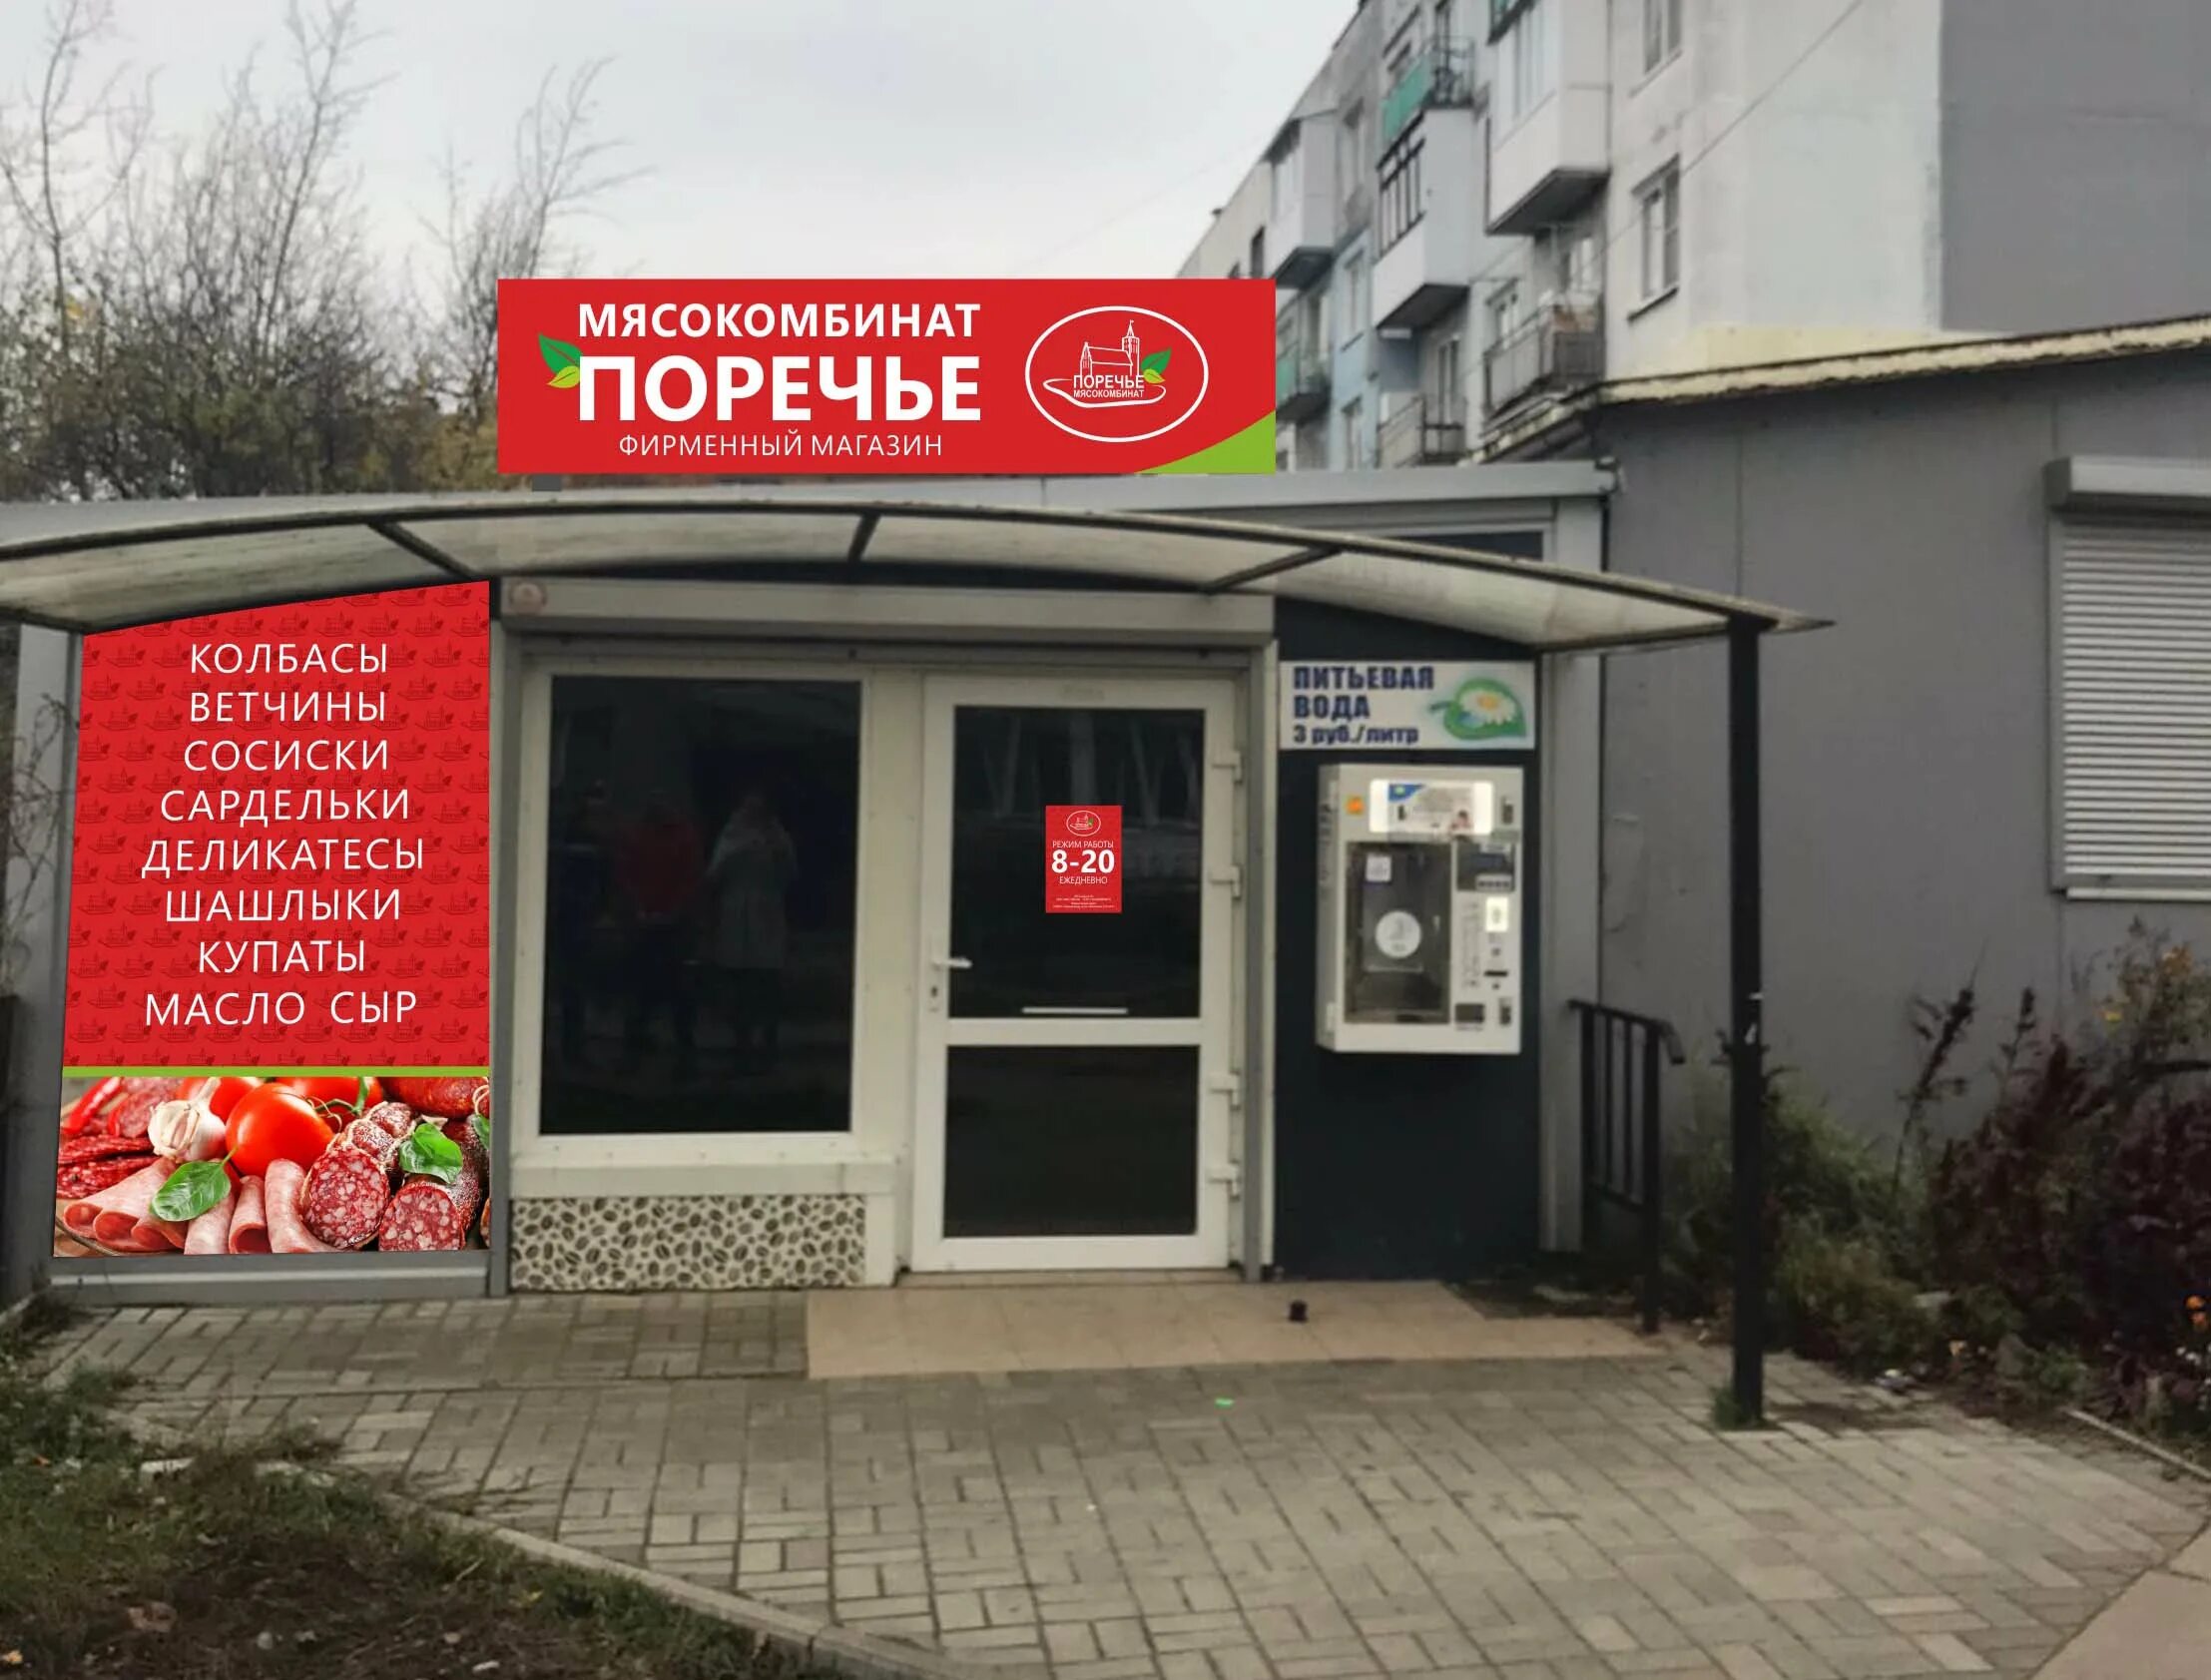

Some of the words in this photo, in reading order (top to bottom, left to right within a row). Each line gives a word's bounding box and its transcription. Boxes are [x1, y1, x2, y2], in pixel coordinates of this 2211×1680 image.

[579, 302, 981, 338] МЯСОКОМБИНАТ
[579, 354, 981, 422] ПОРЕЧЬЕ
[1073, 374, 1145, 389] ПОРЕЧЬЕ
[1073, 389, 1145, 398] МЯСОКОМБИНАТ
[619, 429, 802, 456] ФИРМЕННЫЙ
[812, 434, 941, 456] МАГАЗИН
[191, 643, 387, 674] КОЛБАСЫ
[1293, 665, 1435, 691] ПИТЬЕВАЯ
[190, 691, 386, 723] ВЕТЧИНЫ
[1293, 694, 1372, 723] ВОДА
[1293, 724, 1307, 745] 3
[1311, 724, 1419, 746] руб./литр
[184, 739, 388, 772] СОСИСКИ
[161, 789, 409, 828] САРДЕЛЬКИ
[141, 838, 423, 879] ДЕЛИКАТЕСЫ
[1051, 849, 1115, 873] 8-20
[1059, 875, 1108, 885] ЕЖЕДНЕВНО
[166, 888, 400, 922] ШАШЛЫКИ
[199, 939, 365, 973] КУПАТЫ
[146, 991, 305, 1026] МАСЛО
[330, 990, 417, 1024] СЫР
